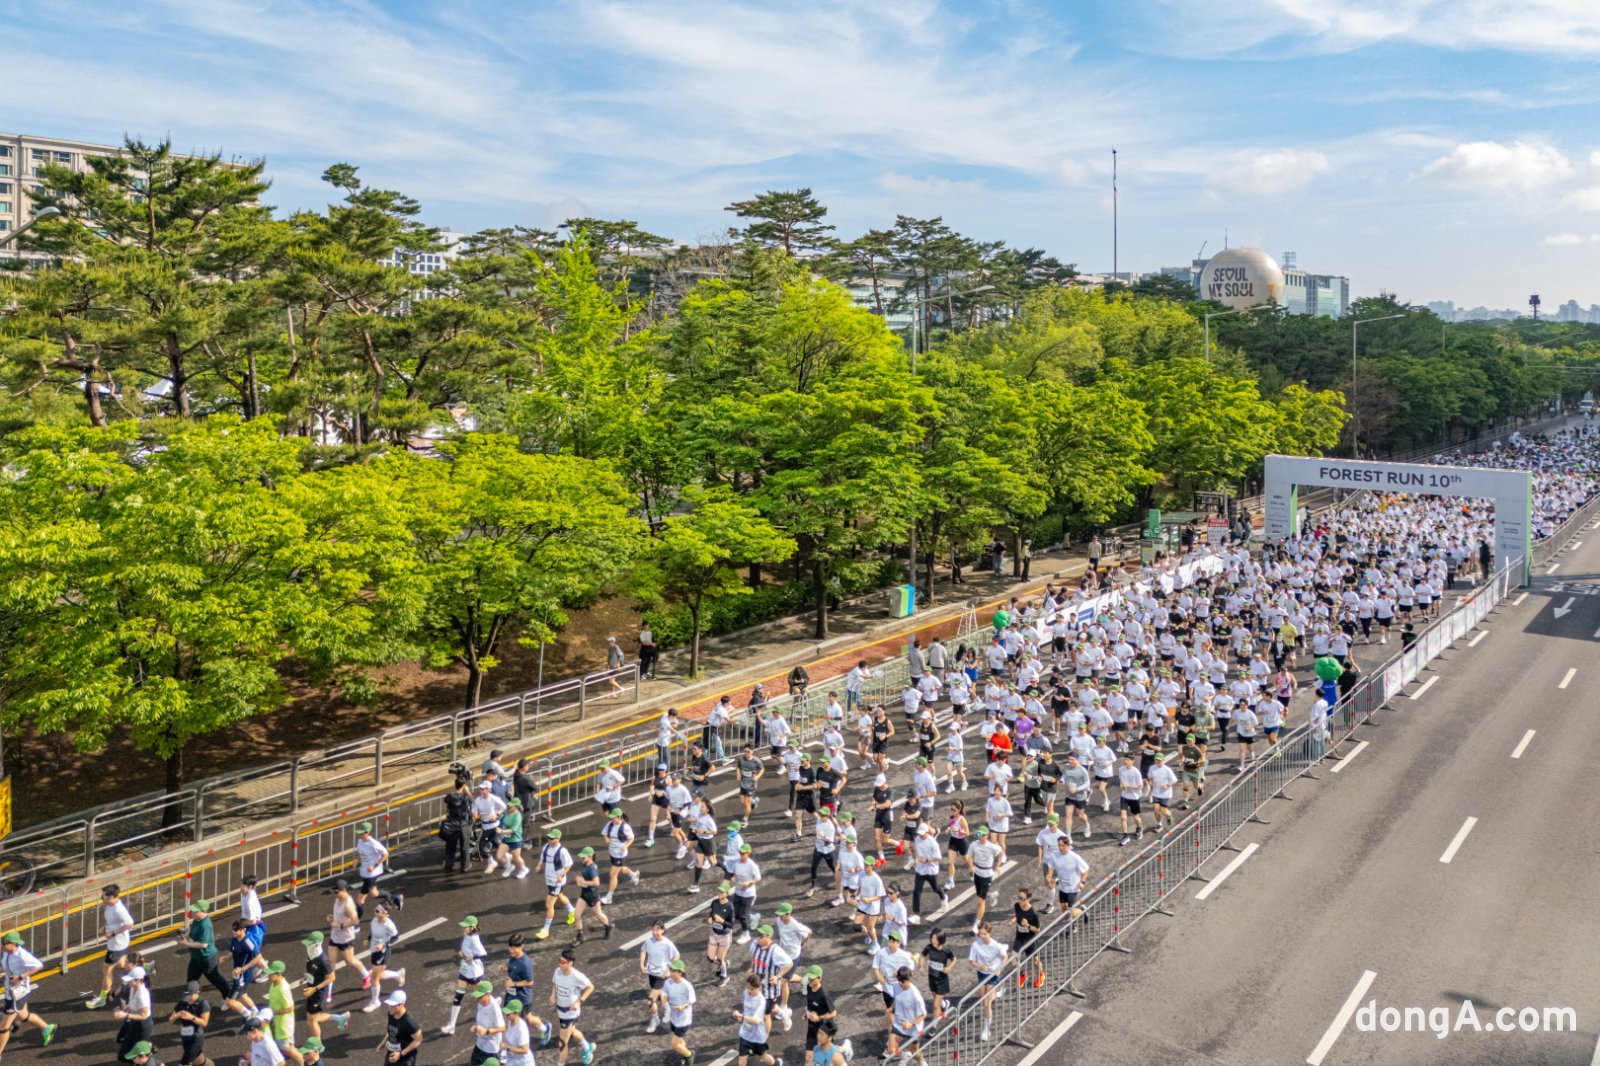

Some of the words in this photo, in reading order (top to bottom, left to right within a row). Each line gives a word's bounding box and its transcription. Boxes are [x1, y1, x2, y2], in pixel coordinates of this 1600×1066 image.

[1213, 267, 1248, 282] SEOUL
[1225, 282, 1254, 297] SOUL
[1319, 467, 1383, 483] FOREST
[1387, 471, 1424, 486] RUN
[1429, 474, 1462, 488] 10th
